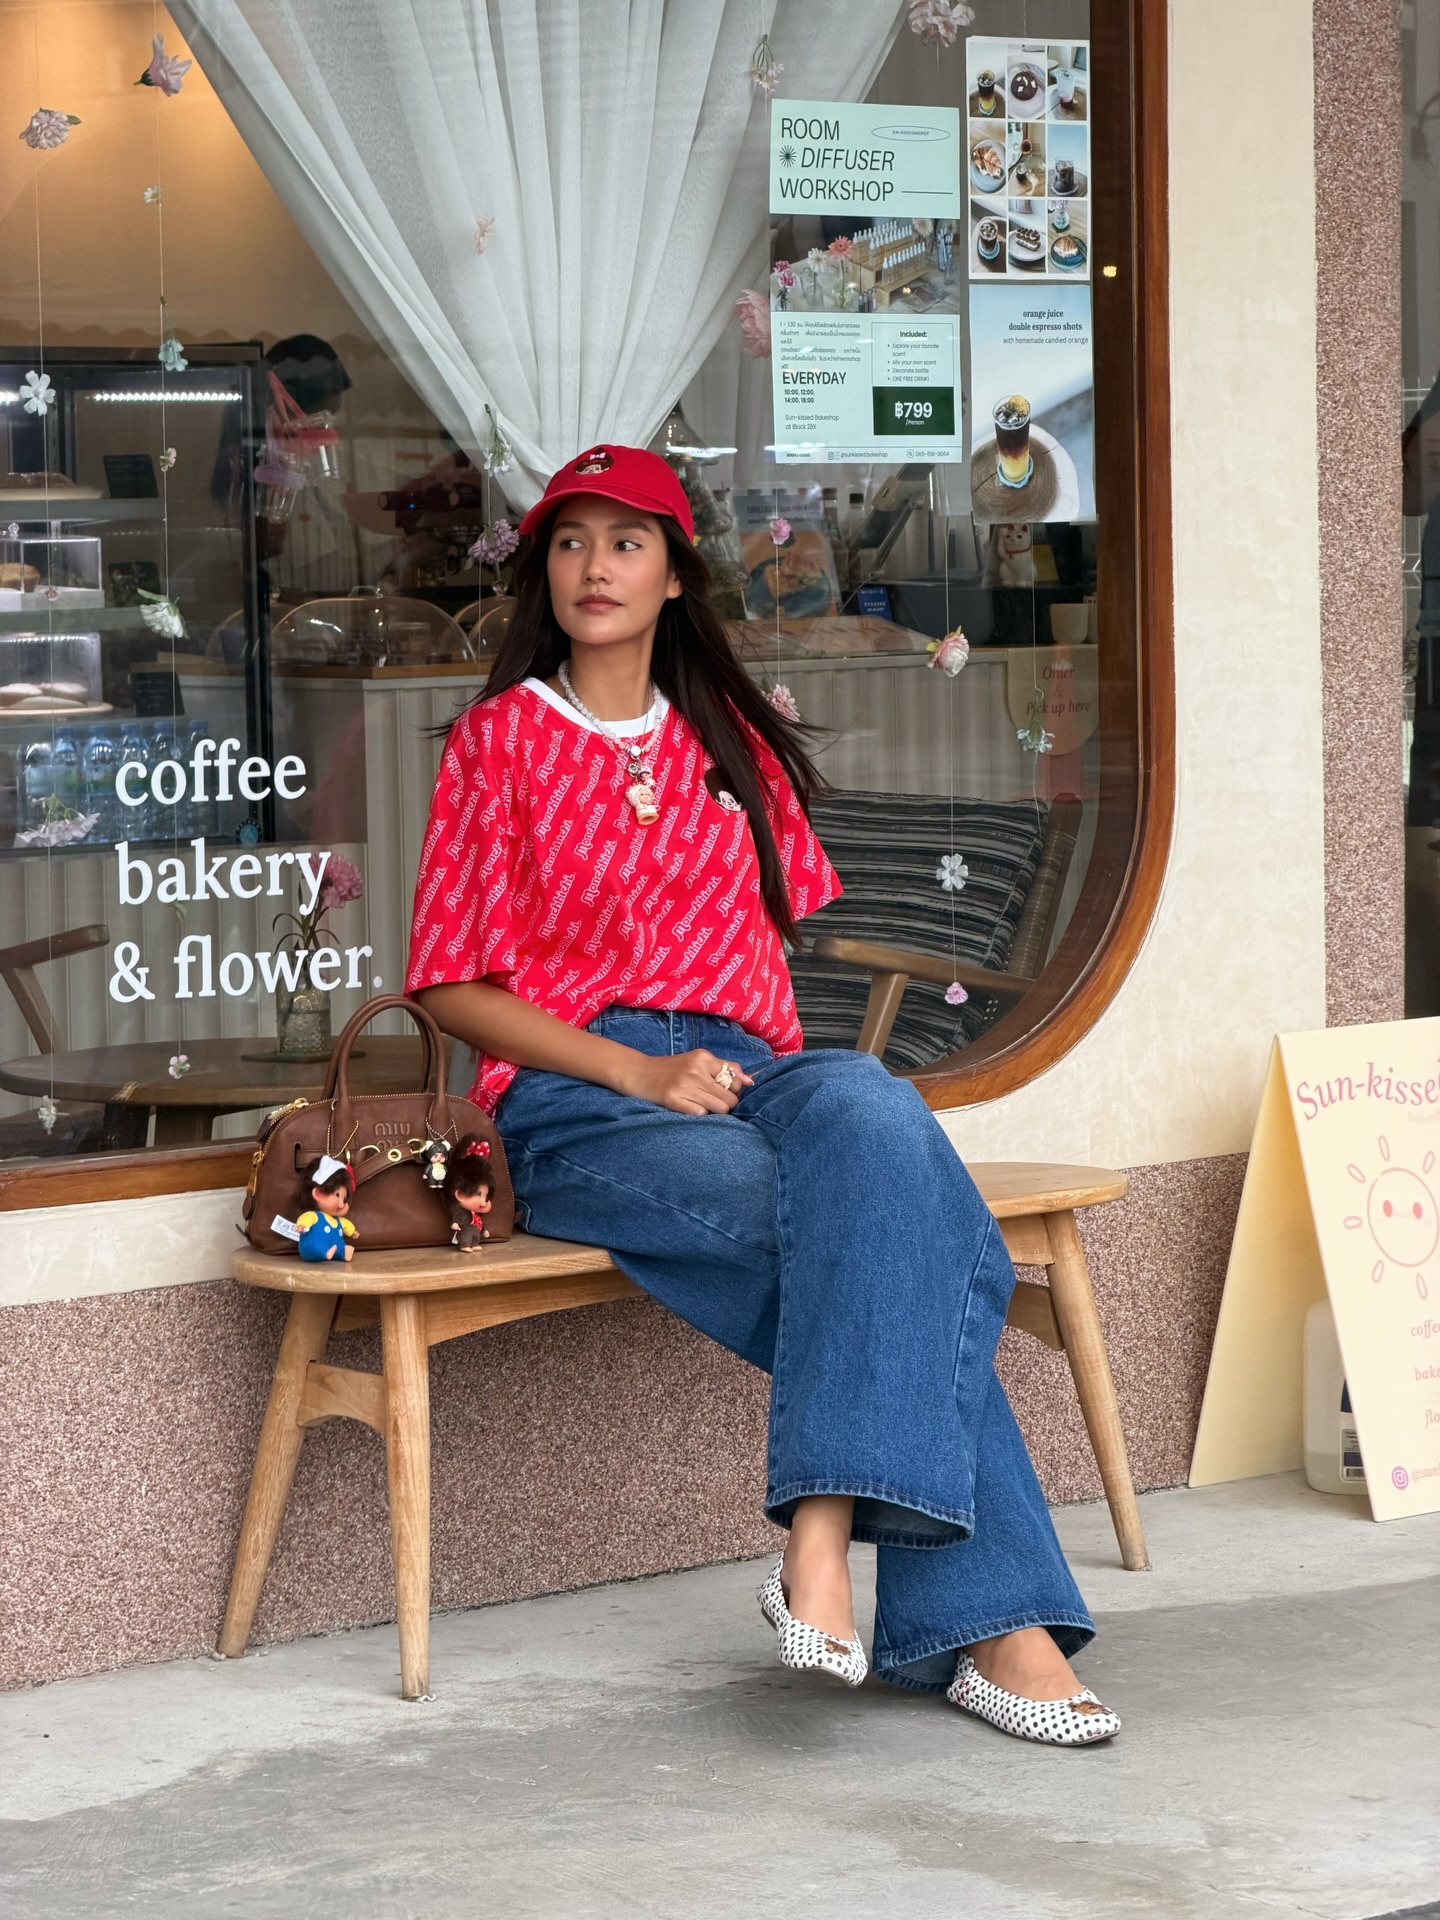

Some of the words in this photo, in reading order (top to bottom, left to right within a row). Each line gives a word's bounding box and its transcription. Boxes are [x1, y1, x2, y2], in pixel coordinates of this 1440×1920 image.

[782, 118, 840, 140] ROOM
[801, 147, 895, 171] DIFFUSER
[780, 177, 894, 201] WORKSHOP
[1009, 322, 1031, 331] double
[1032, 324, 1062, 332] espresso
[1063, 322, 1083, 331] shots
[1023, 310, 1046, 319] orange
[1047, 309, 1064, 319] juice
[1068, 337, 1089, 345] orange
[783, 372, 847, 385] EVERYDAY
[906, 418, 925, 426] /Person
[1043, 666, 1075, 680] Order
[1052, 704, 1065, 717] up
[1069, 699, 1091, 713] here
[115, 738, 307, 807] coffee
[447, 791, 480, 861] Monchhichi
[535, 774, 574, 842] Monchhichi
[115, 837, 331, 916] bakery
[581, 840, 617, 907] Monchhichi
[687, 823, 722, 890] Monchhichi
[538, 873, 575, 940] Monchhichi
[584, 895, 620, 958] Monchhichi
[672, 875, 722, 943] Monchhichi
[109, 941, 155, 1003] &
[174, 934, 383, 999] flower.
[409, 923, 443, 990] Monchhichi
[700, 952, 746, 1011] Monchhichi
[1297, 1056, 1440, 1121] Sun-kisse
[1411, 1319, 1440, 1339] coffe
